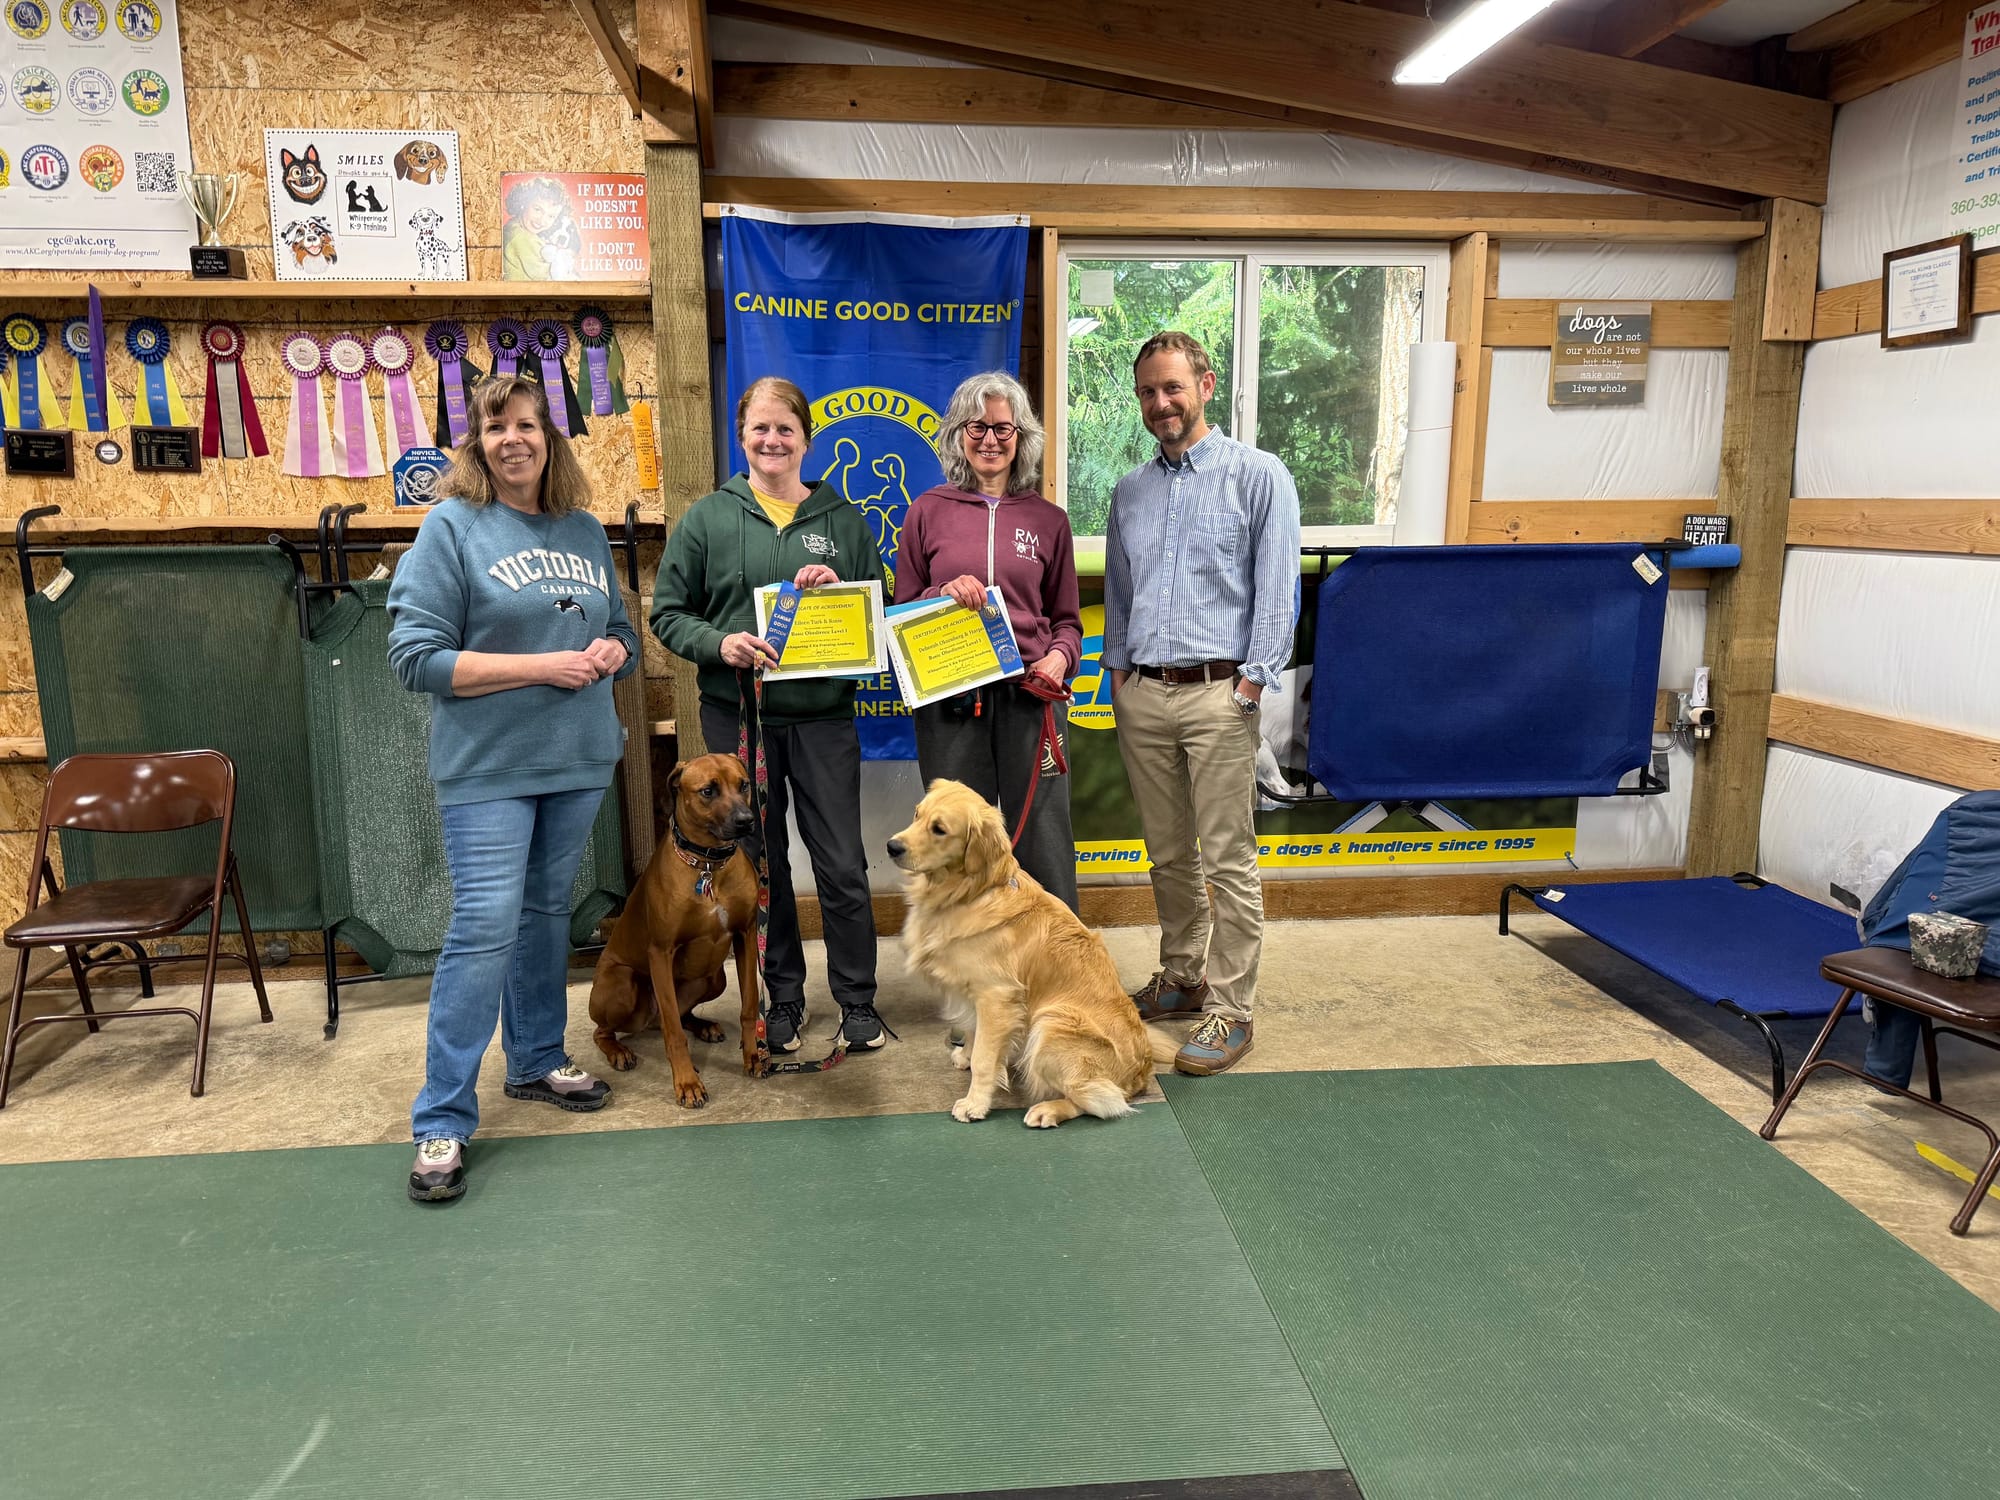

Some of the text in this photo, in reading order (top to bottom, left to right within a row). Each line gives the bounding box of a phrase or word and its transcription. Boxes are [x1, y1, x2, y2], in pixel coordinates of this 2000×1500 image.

[22, 67, 46, 76] TRICK
[45, 74, 58, 91] DOG
[124, 71, 137, 89] AKC
[149, 72, 165, 90] DOG
[1965, 94, 1985, 108] and
[34, 156, 56, 175] ATT
[337, 155, 384, 165] SMILES
[1965, 169, 1985, 182] and
[577, 184, 643, 197] IF MY DOG
[585, 200, 638, 213] DOESN'T
[1951, 193, 2000, 215] 360-39
[349, 214, 382, 224] Whispering
[580, 217, 645, 231] LIKE YOU,
[363, 223, 387, 232] Training
[47, 235, 116, 248] cgc@akc.org
[6, 247, 161, 257] www.AKC.org/sports/akc-family-dog-program/
[590, 242, 634, 255] I DON'T
[581, 259, 645, 272] LIKE YOU.
[734, 291, 828, 320] CANINE
[835, 301, 910, 321] GOOD
[1569, 306, 1622, 345] dogs
[1626, 333, 1642, 341] not
[1566, 346, 1641, 355] our whole lives
[1583, 358, 1623, 369] but they
[1579, 371, 1602, 379] make
[1572, 384, 1627, 393] lives whole
[823, 392, 910, 419] GOOD
[1707, 517, 1727, 525] WAGS
[1684, 531, 1725, 546] HEART
[488, 548, 610, 599] VICTORIA
[541, 585, 591, 596] CANADA
[949, 613, 979, 626] ACHIEVEMEN
[1276, 842, 1323, 856] dogs
[1328, 842, 1342, 855] &
[1347, 840, 1434, 854] handlers
[1437, 839, 1488, 852] since
[1494, 837, 1536, 850] 1995
